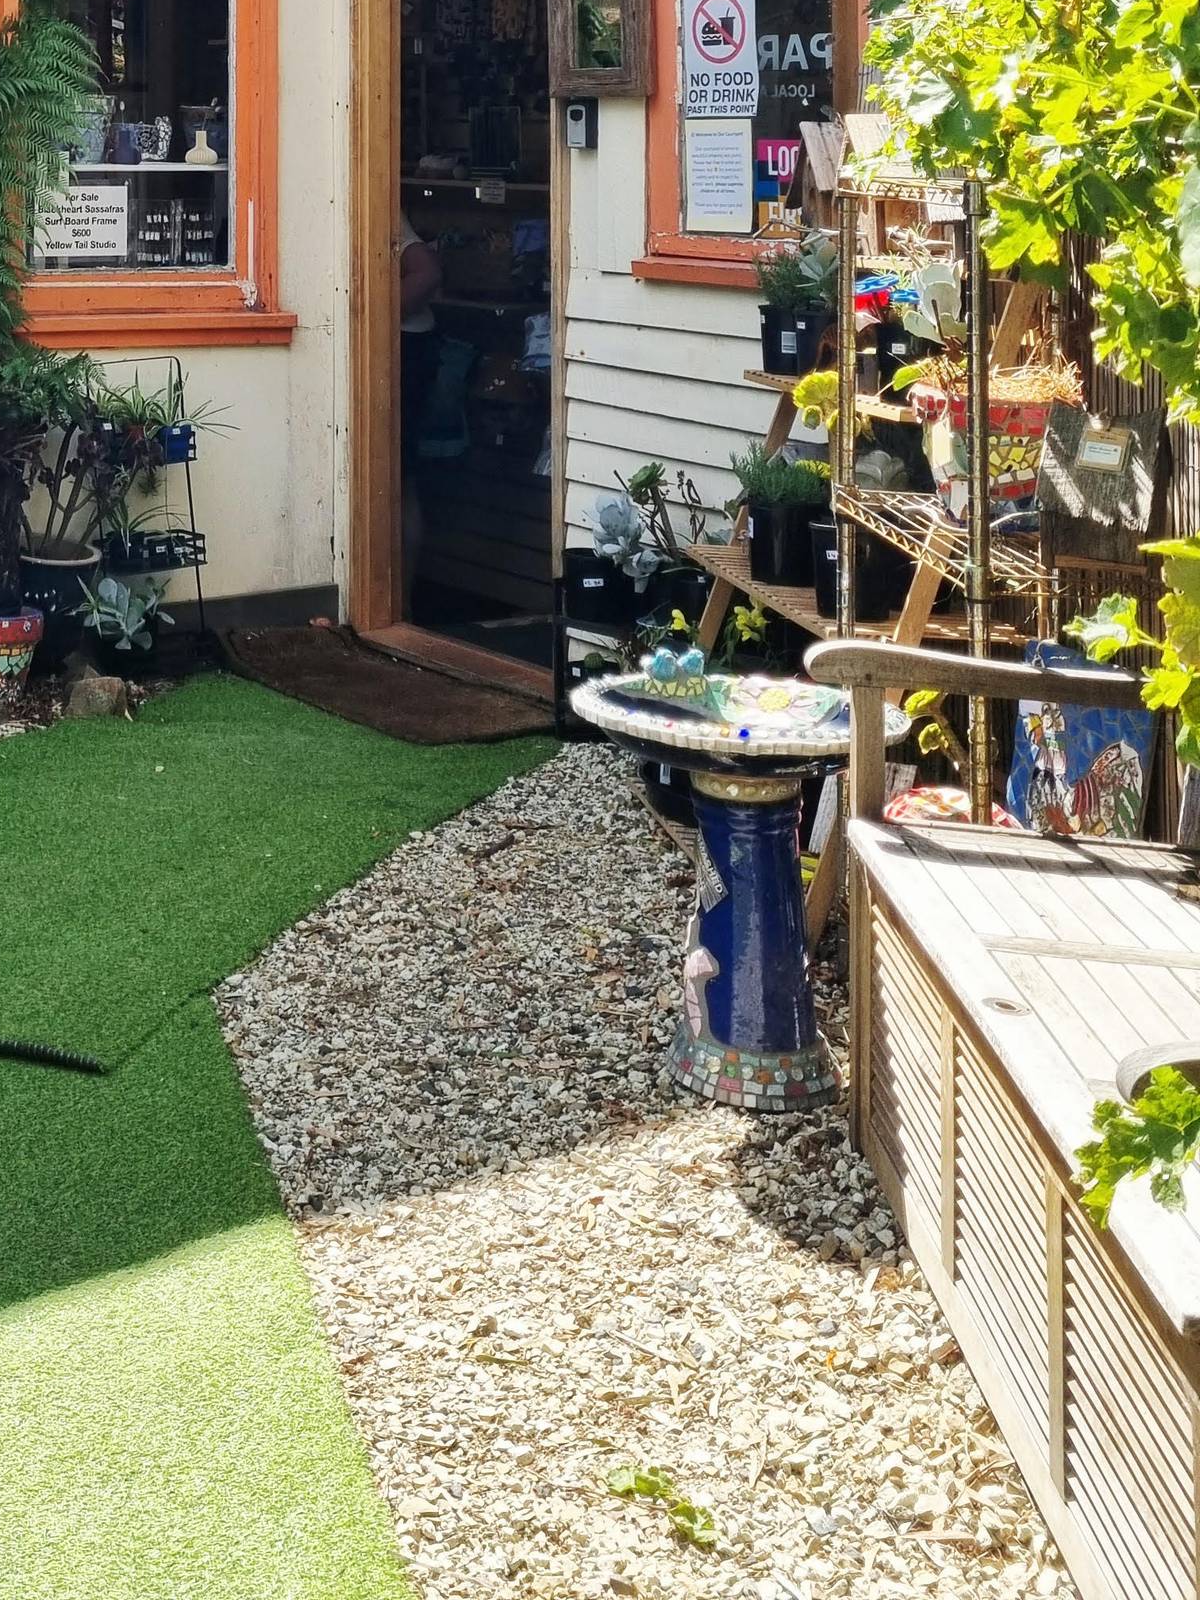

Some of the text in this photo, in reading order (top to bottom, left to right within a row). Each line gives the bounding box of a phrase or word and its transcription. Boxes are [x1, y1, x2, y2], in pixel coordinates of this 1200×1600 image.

[690, 72, 754, 87] NO FOOD
[688, 89, 708, 103] OR
[712, 88, 755, 103] DRINK
[687, 104, 755, 114] PAST THIS POINT
[767, 145, 799, 177] LOC
[81, 193, 99, 202] Sale
[85, 204, 125, 214] Sassafras
[44, 216, 118, 226] Surf Board Frame
[71, 228, 91, 238] $600
[45, 240, 117, 250] Yellow Tail Studio
